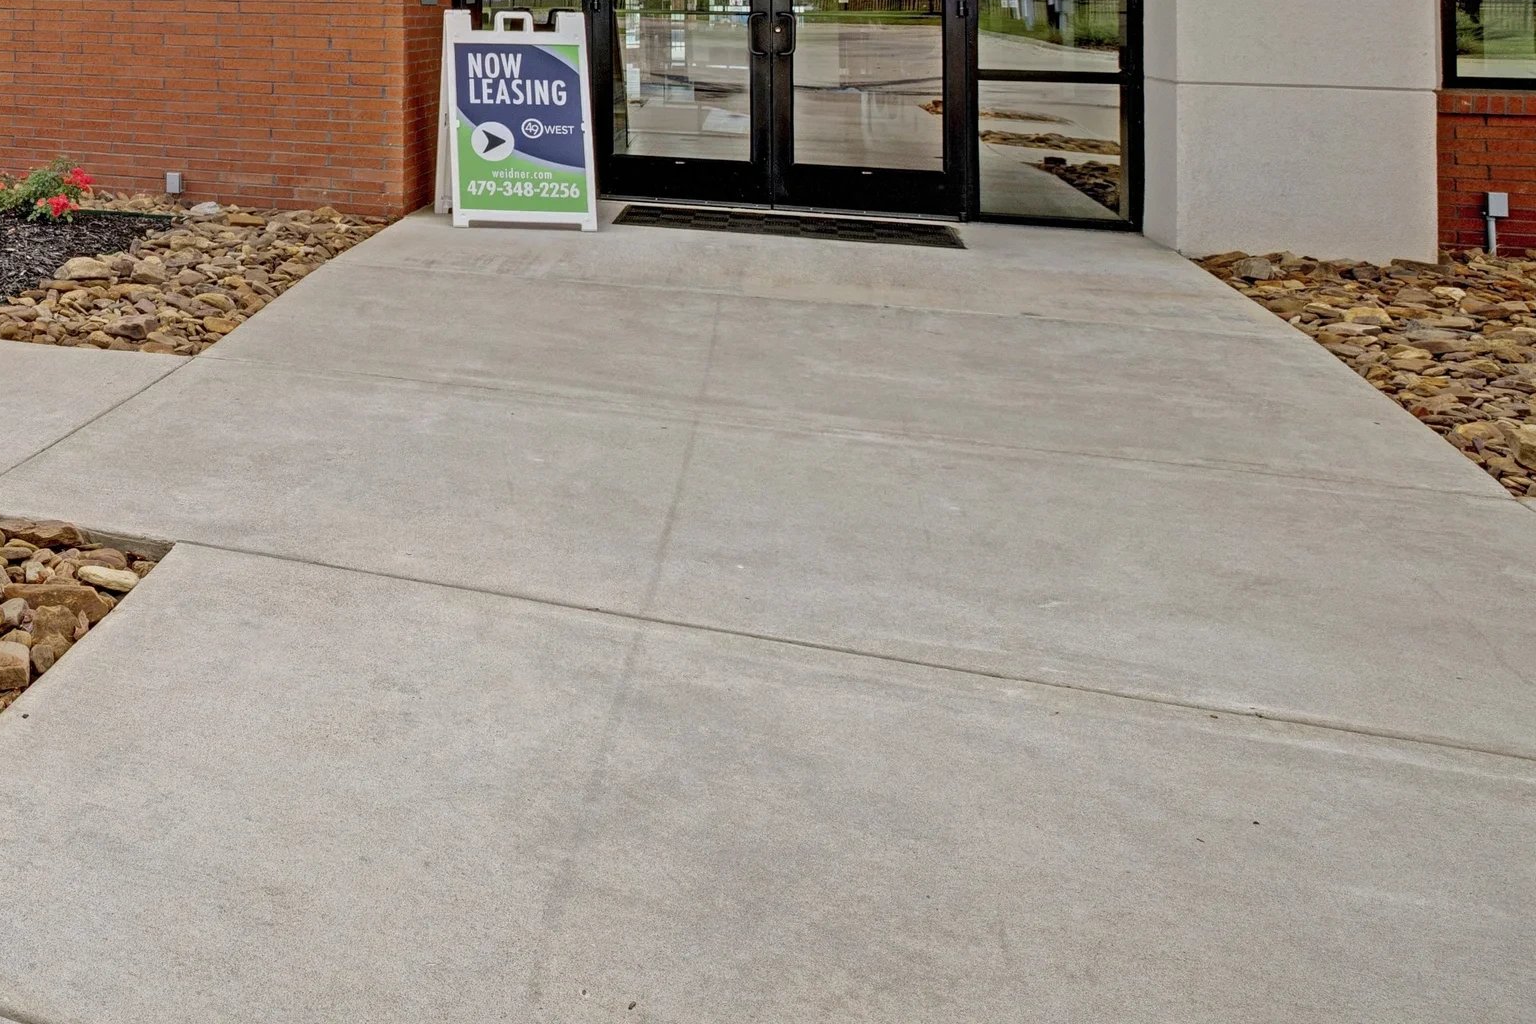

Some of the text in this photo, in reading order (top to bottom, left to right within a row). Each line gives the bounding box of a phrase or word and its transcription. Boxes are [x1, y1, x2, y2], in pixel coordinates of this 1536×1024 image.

[467, 52, 522, 79] NOW
[469, 78, 567, 106] LEASING
[544, 125, 575, 135] WEST
[492, 168, 553, 180] weidner.com
[467, 180, 580, 198] 479-348-2256
